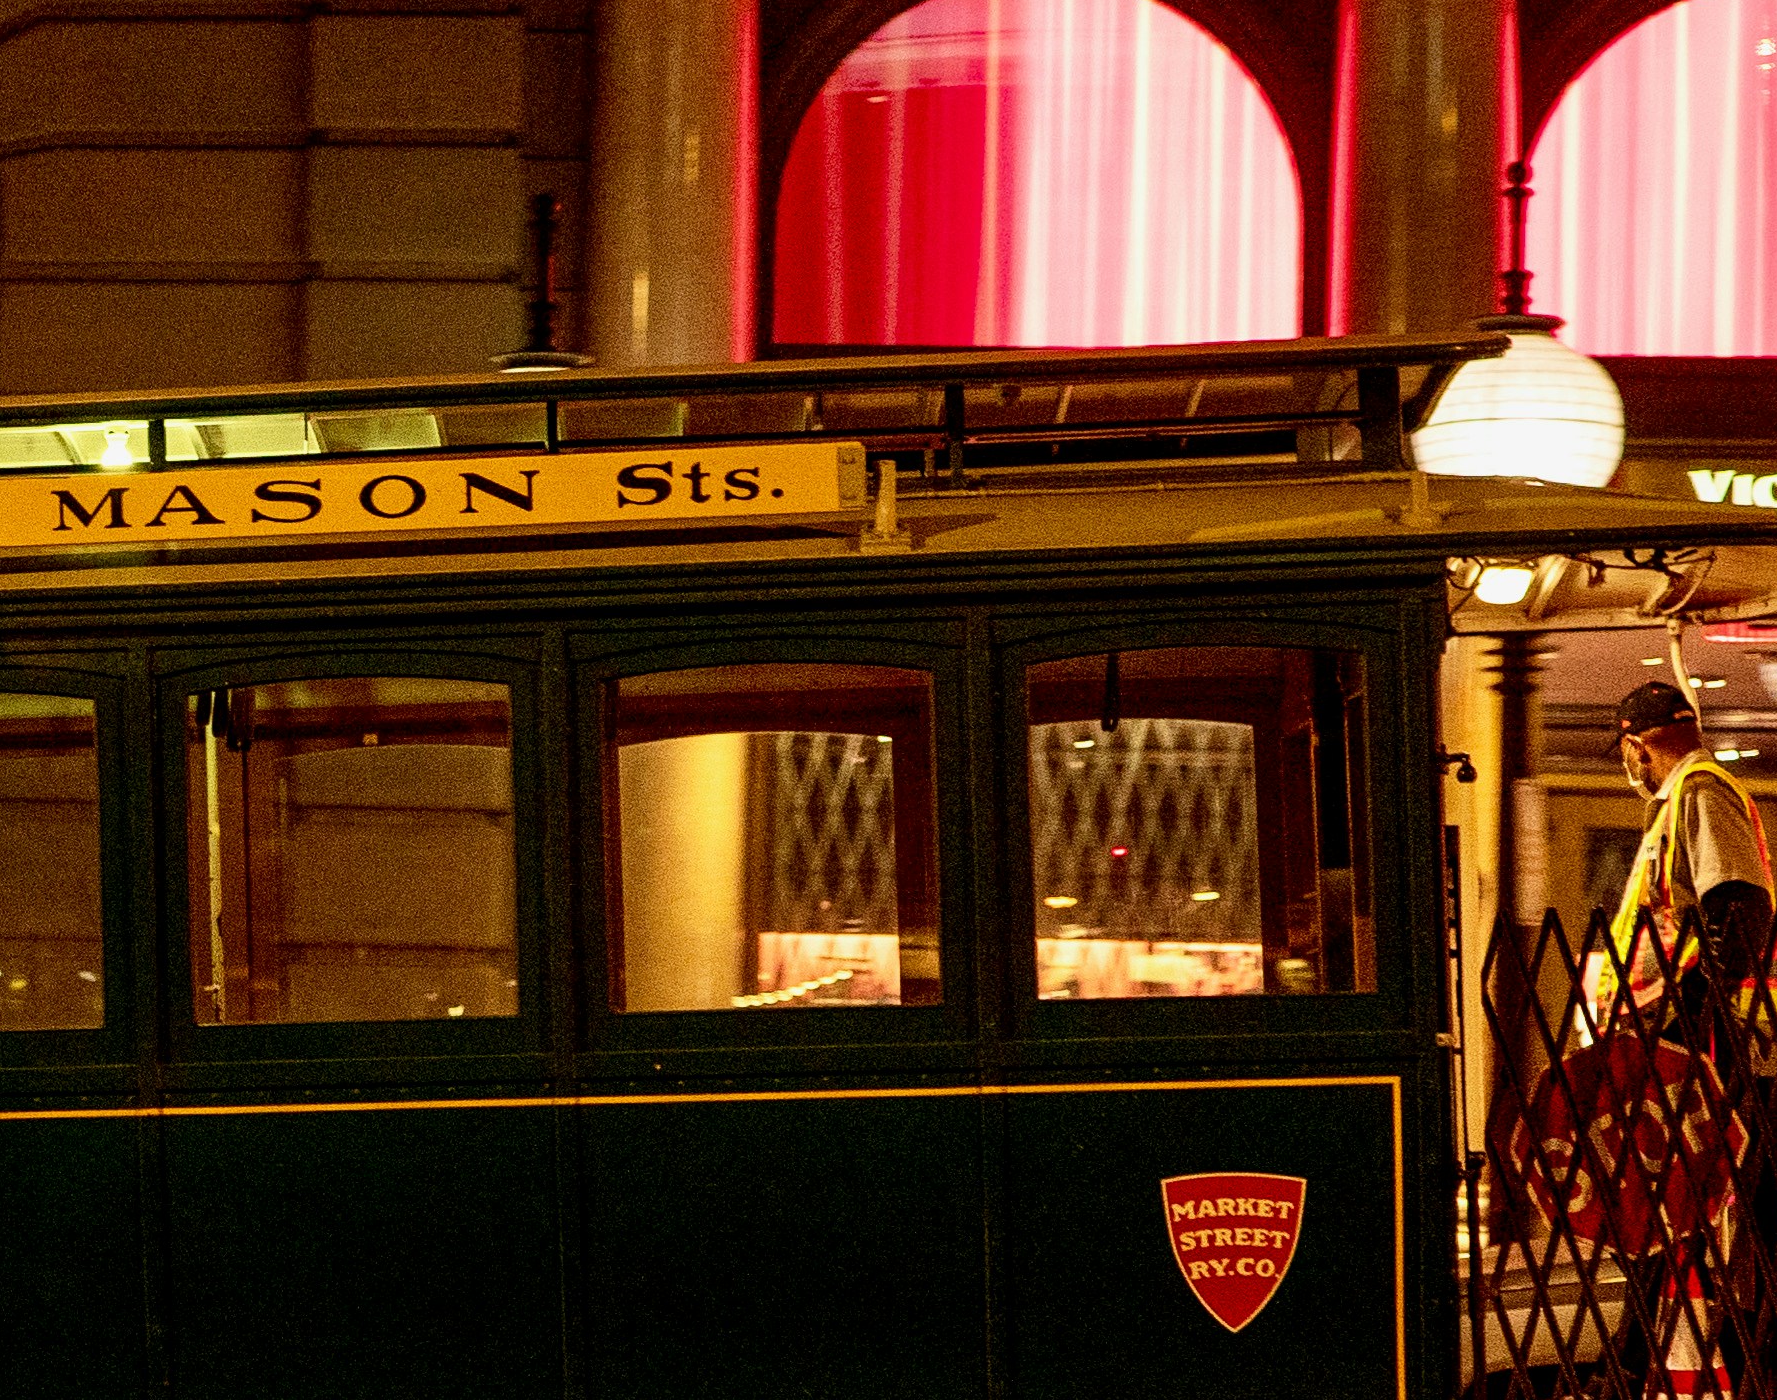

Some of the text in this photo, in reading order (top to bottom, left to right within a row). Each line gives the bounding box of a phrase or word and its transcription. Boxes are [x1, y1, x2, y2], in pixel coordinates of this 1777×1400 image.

[51, 469, 541, 532] MASON
[615, 460, 786, 508] Sts.
[1170, 1197, 1295, 1223] MARKET
[1179, 1227, 1291, 1252] STREET
